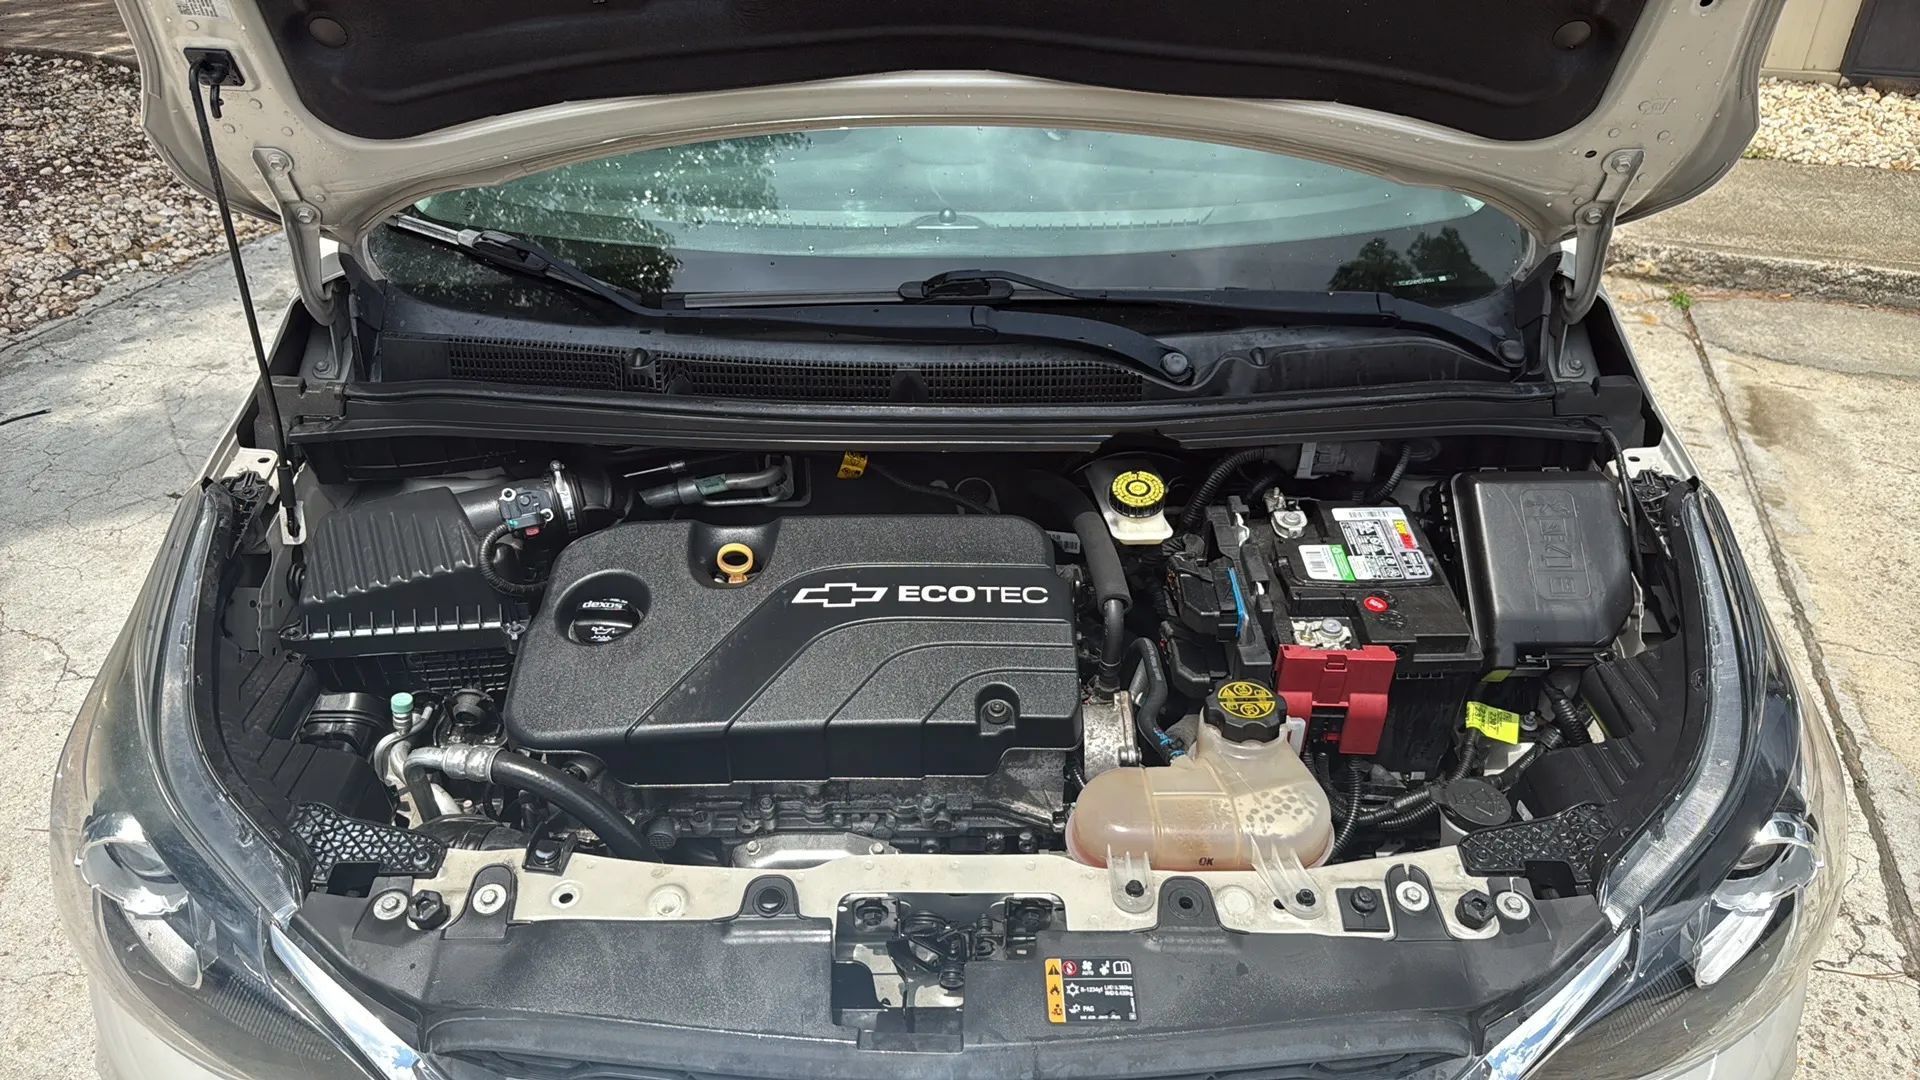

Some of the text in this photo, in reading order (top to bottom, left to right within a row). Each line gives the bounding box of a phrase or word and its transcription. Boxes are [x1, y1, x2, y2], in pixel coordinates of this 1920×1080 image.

[898, 585, 1049, 604] ECOTEC
[582, 600, 623, 609] dexos
[1199, 856, 1214, 866] OK
